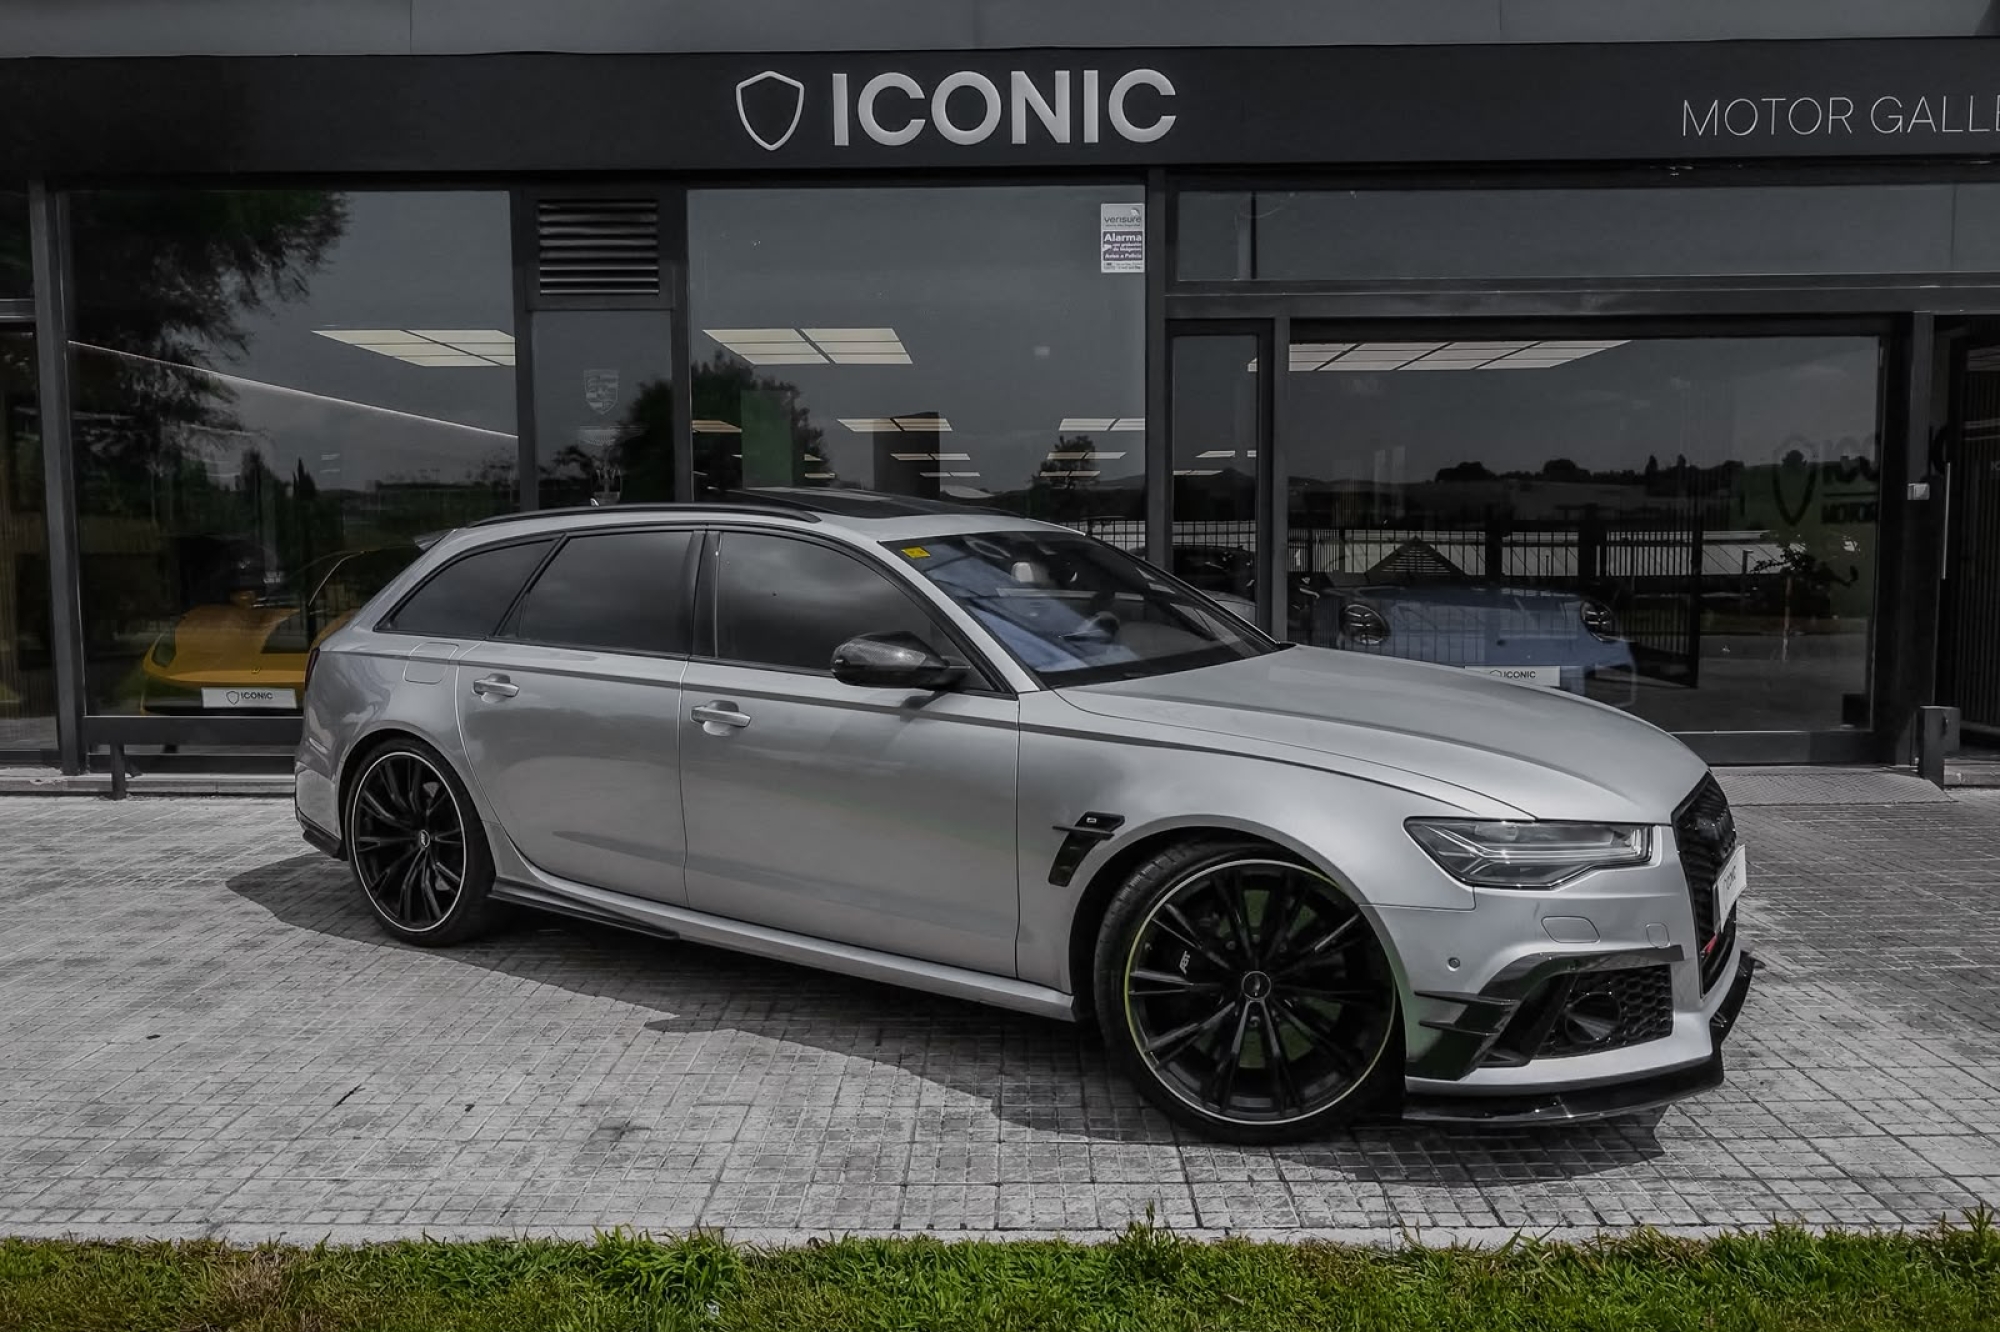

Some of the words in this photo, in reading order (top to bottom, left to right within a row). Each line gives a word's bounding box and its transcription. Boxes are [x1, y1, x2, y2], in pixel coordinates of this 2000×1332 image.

[832, 69, 1176, 146] ICONIC
[1683, 97, 1854, 136] MOTOR
[1870, 95, 2000, 135] GALL
[1104, 233, 1142, 241] Alarma
[1503, 671, 1536, 679] ICONIC
[240, 692, 274, 700] ICONIC
